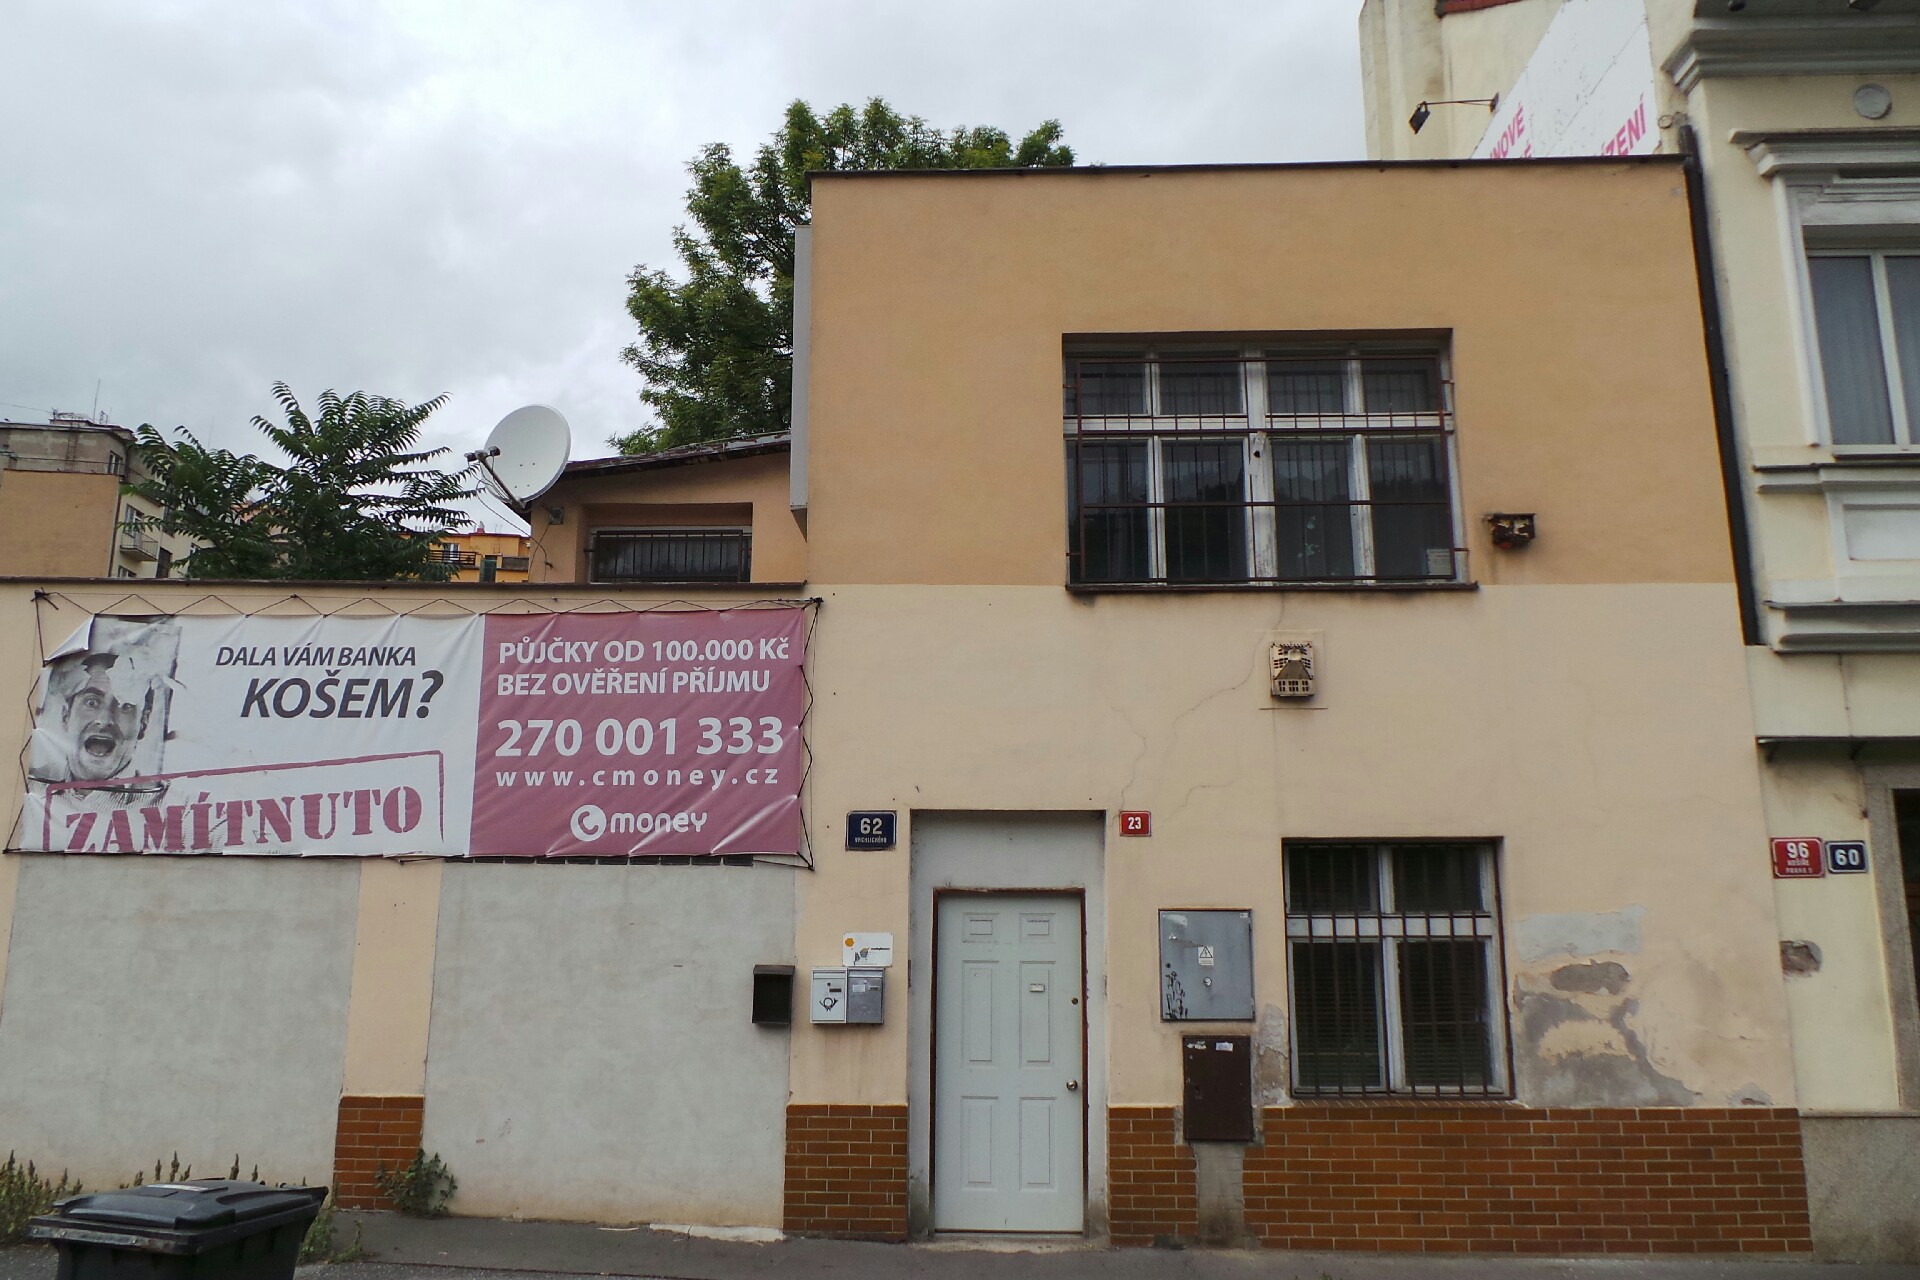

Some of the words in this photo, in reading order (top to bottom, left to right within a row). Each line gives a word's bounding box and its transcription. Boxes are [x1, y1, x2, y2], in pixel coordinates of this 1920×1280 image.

[215, 647, 276, 666] DALA
[283, 643, 335, 666] VÁM
[337, 647, 416, 666] BANKA
[500, 636, 598, 663] PŮJČKY
[603, 641, 645, 662] OD
[652, 639, 753, 661] 100.000
[759, 637, 789, 659] Kč
[497, 673, 547, 696] BEZ
[552, 667, 668, 695] OVĚŘENÍ
[672, 666, 770, 693] PŘÍJMU
[240, 669, 444, 718] KOŠEM?
[495, 719, 583, 756] 270
[595, 717, 676, 755] 001
[696, 716, 784, 754] 333
[495, 768, 778, 790] www.cmoney.cz
[65, 791, 422, 852] ZAMÍTNUTO
[860, 817, 883, 835] 62
[1127, 816, 1142, 830] 23
[1787, 842, 1809, 859] 96
[1835, 849, 1860, 865] 60
